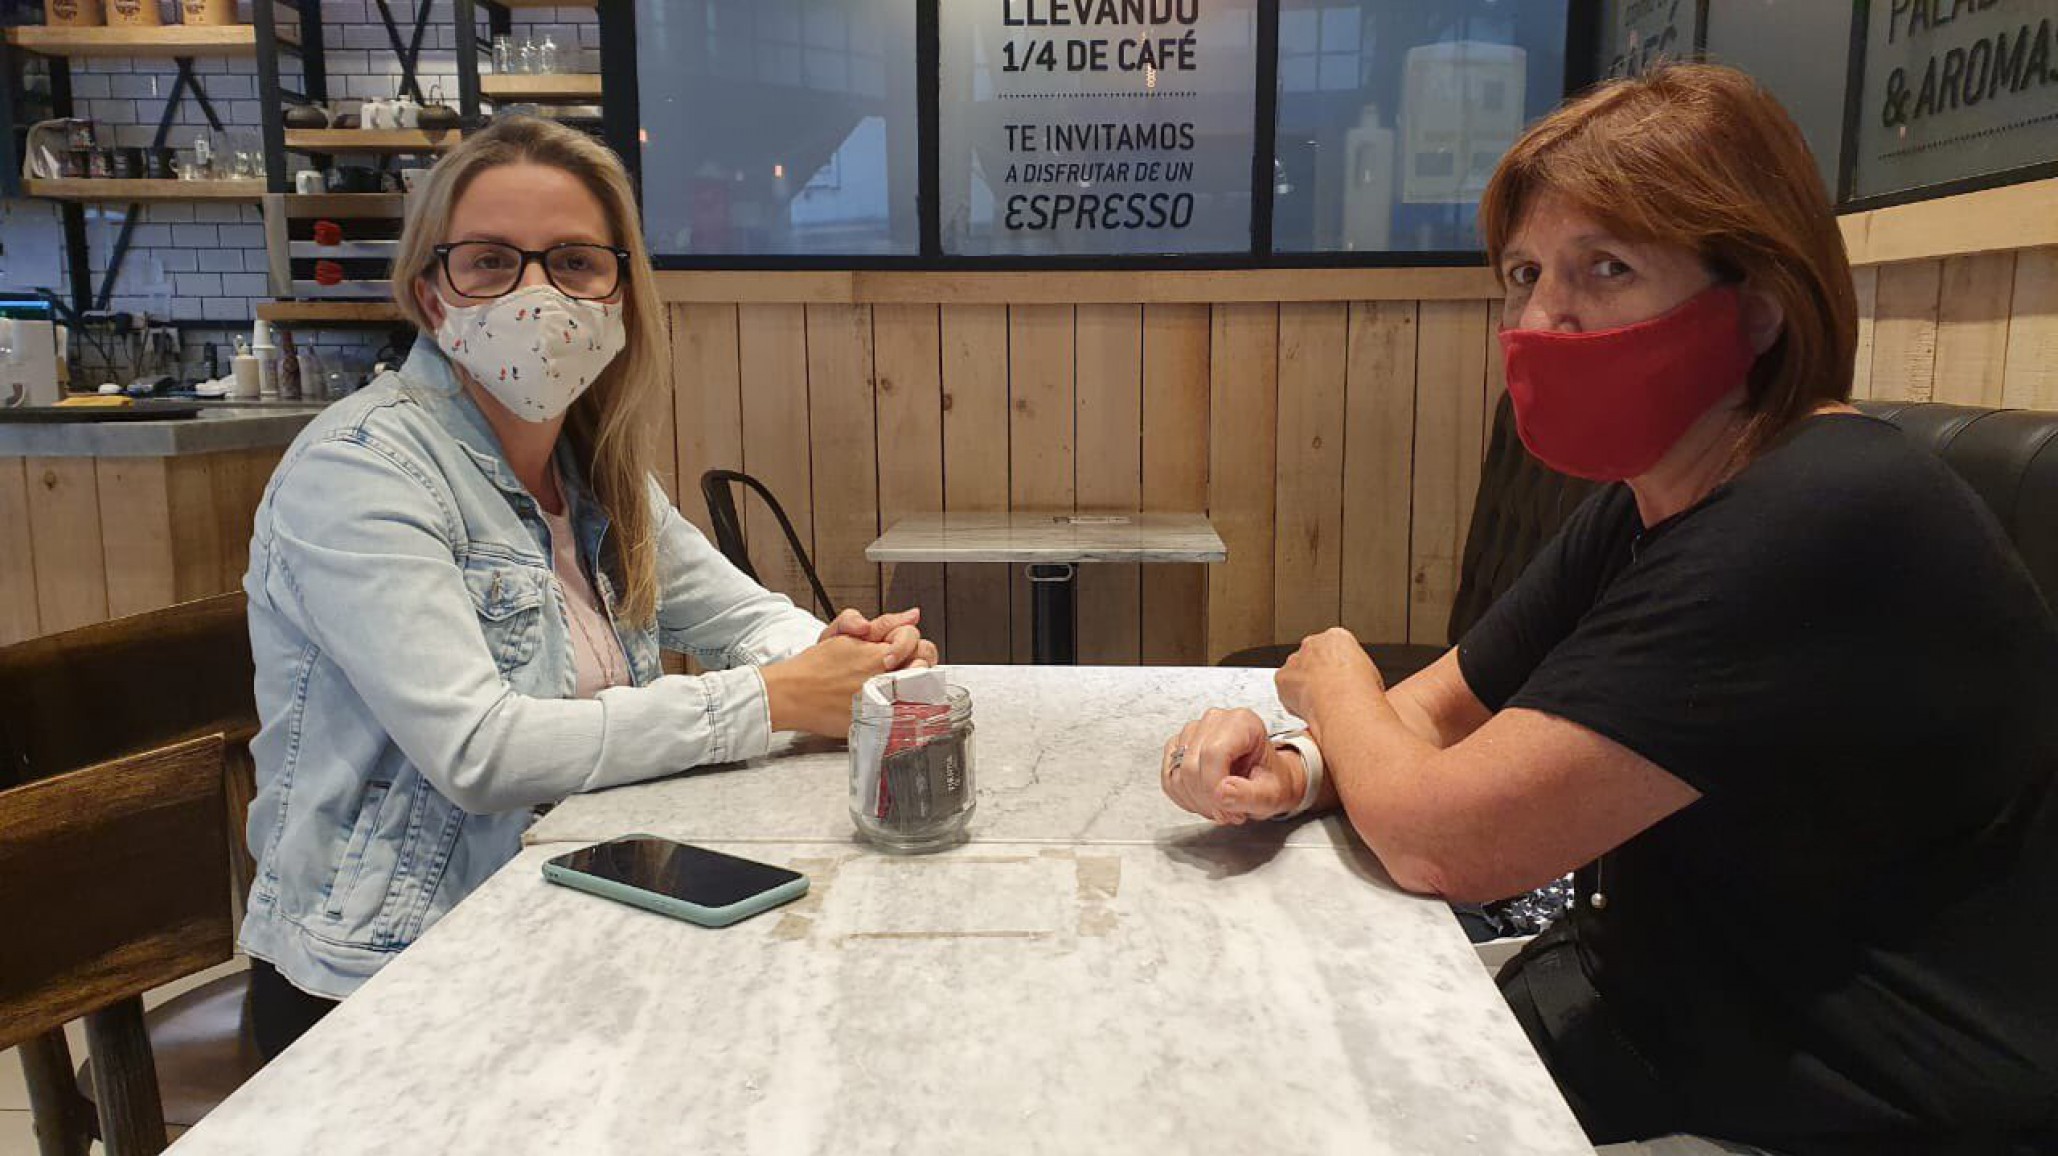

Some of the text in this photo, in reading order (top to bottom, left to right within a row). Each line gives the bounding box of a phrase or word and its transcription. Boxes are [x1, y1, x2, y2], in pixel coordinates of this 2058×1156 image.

[1003, 0, 1198, 26] LLEVANDO
[1002, 29, 1197, 71] 1/4 DE CAFÉ
[1883, 67, 1910, 127] &
[1913, 18, 2058, 119] AROMA
[1005, 123, 1195, 151] TE INVITAMOS
[1005, 162, 1194, 183] A DISFRUTAR DE UN
[1005, 192, 1194, 230] ESPRESSO
